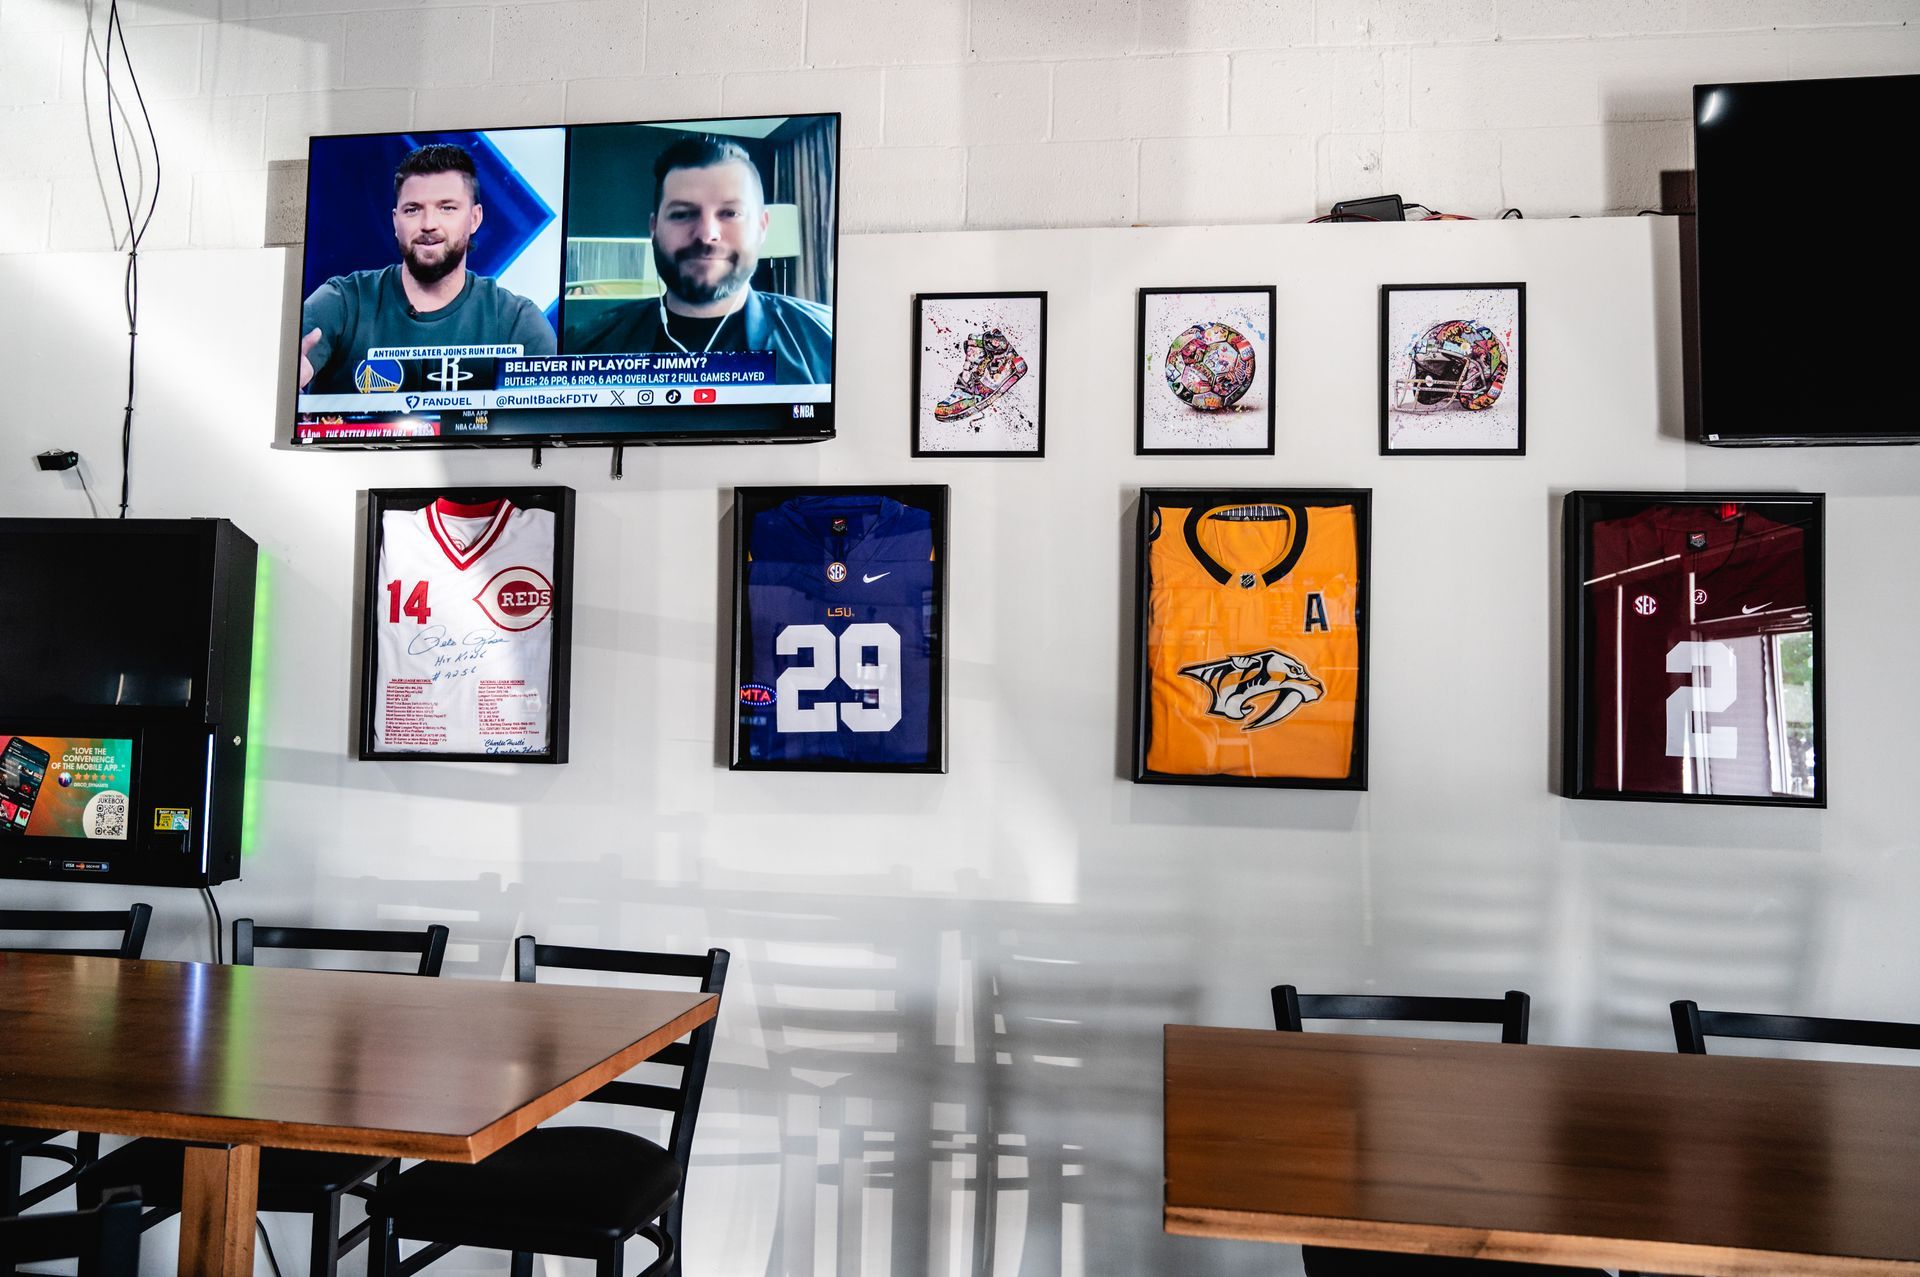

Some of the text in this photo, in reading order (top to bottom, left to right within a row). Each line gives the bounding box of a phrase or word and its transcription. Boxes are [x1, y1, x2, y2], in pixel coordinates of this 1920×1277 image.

[373, 346, 518, 358] ANTHONY SLATER JOINS RUN IT BACK
[505, 357, 707, 373] BELIEVER IN PLAYOFF JIMMY?
[504, 371, 765, 387] BUTLER: 26 PPG, 6 RPG, 6 APG OVER LAST 2 FULL GAMES PLAYED
[422, 397, 472, 407] FANDUEL
[496, 393, 598, 407] @RunItBackFDTV
[800, 404, 815, 418] NBA
[829, 564, 845, 580] SEC
[387, 580, 432, 625] 14
[501, 591, 551, 607] REDS
[1634, 594, 1657, 615] SEC
[827, 607, 852, 618] LSU
[1303, 591, 1331, 634] A
[776, 623, 902, 732] 29
[1665, 641, 1738, 760] 2
[62, 755, 115, 763] CONVENIENCE
[72, 747, 107, 755] "LOVE THE
[76, 763, 102, 771] MOBILE
